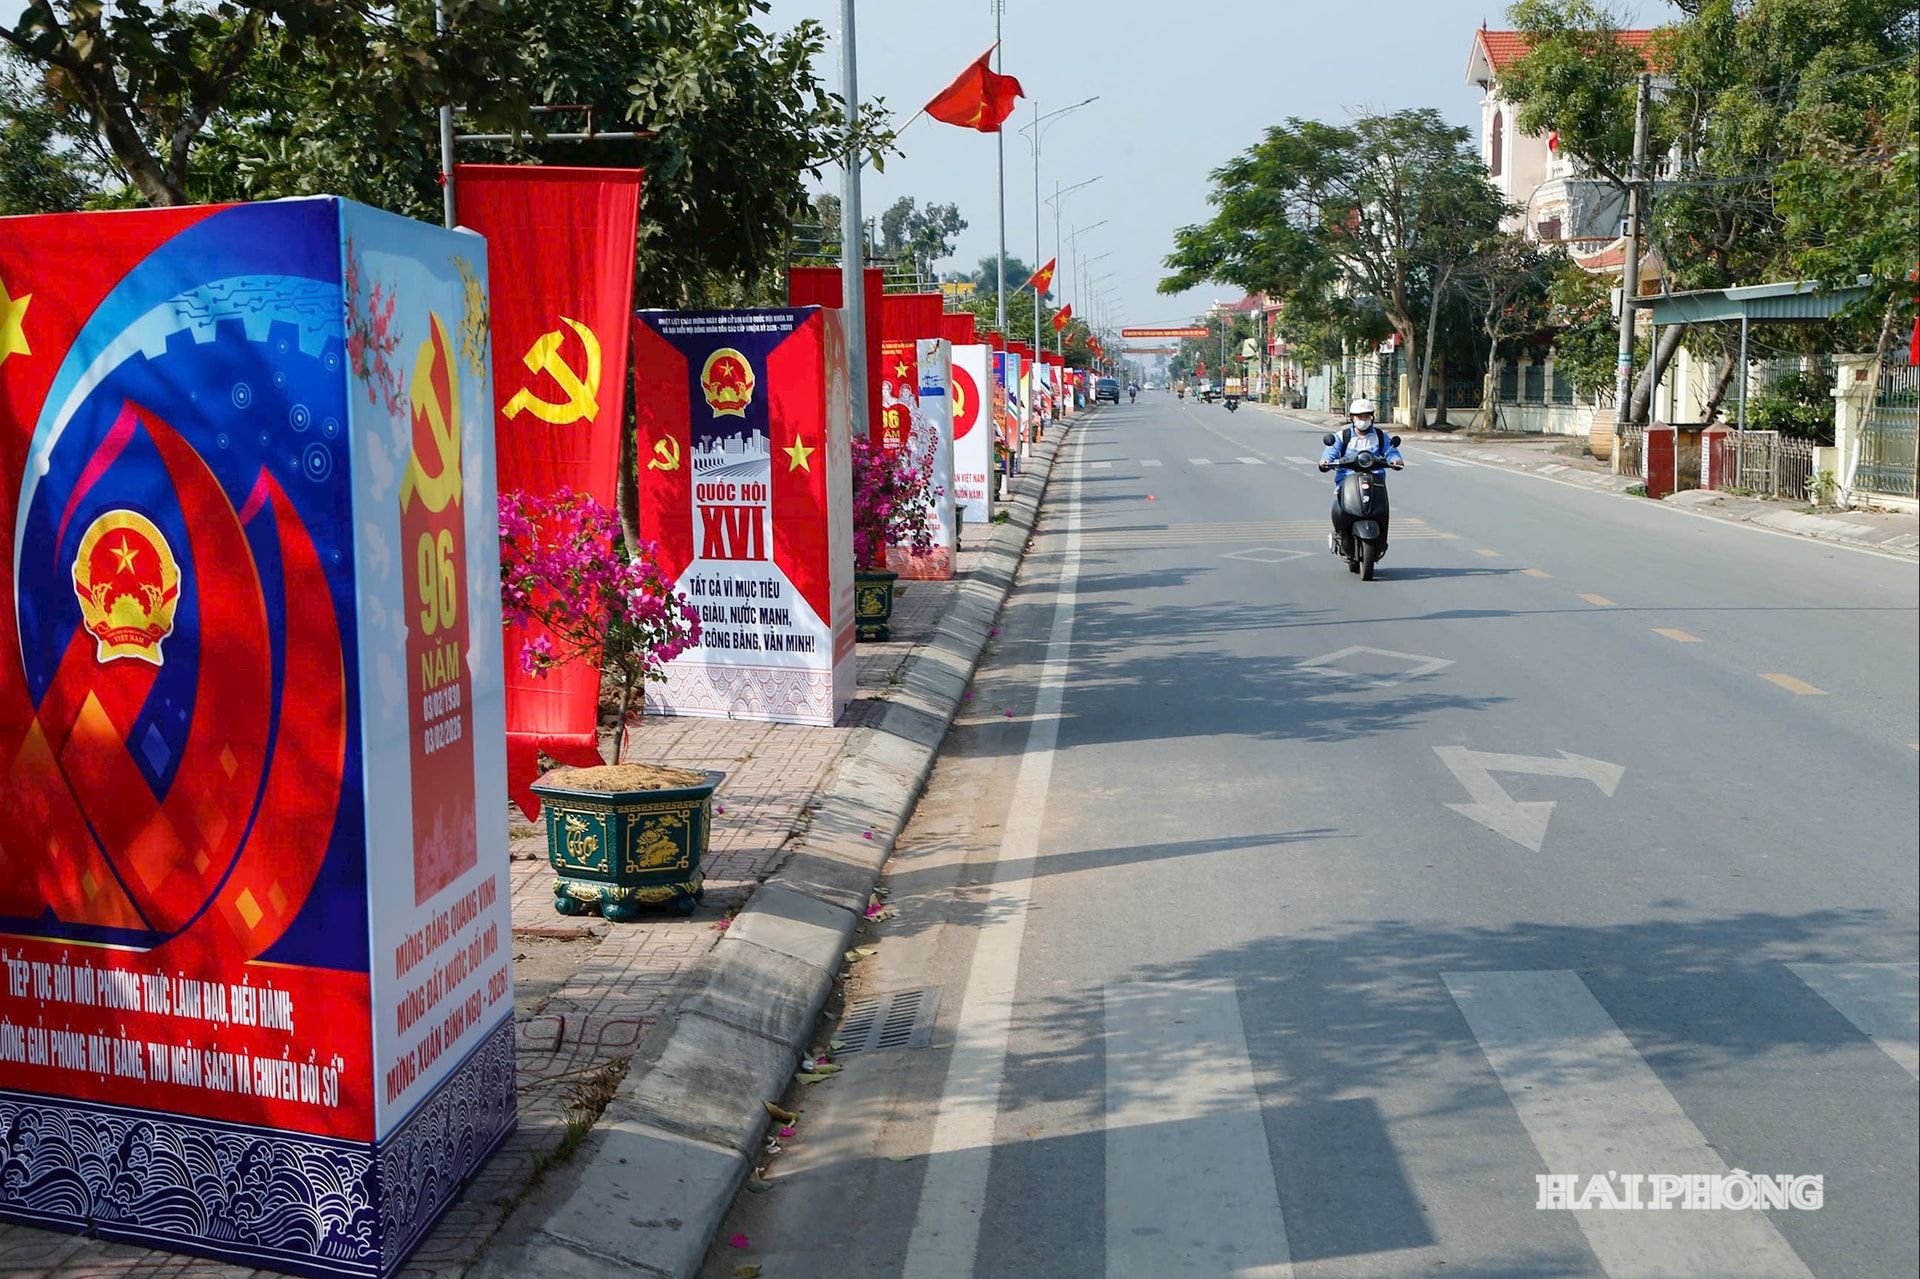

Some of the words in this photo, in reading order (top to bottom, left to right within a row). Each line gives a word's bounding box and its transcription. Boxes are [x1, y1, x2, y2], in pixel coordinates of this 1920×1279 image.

[696, 478, 736, 501] QUỐC
[742, 481, 767, 504] HỘI
[697, 505, 768, 561] XVI
[418, 528, 457, 636] 96
[690, 573, 706, 596] TẤT
[709, 572, 721, 596] CẢ
[724, 576, 733, 597] VÌ
[736, 581, 756, 601] MỤC
[759, 578, 779, 599] TIÊU
[702, 602, 727, 624] GIÀU,
[730, 601, 756, 624] NƯỚC
[760, 608, 792, 628] MẠNH,
[705, 628, 730, 648] CÔNG
[733, 625, 761, 652] BẰNG,
[764, 629, 782, 651] VĂN
[786, 636, 815, 653] MINH!
[421, 635, 460, 692] NĂM
[423, 684, 460, 722] 03/02/1930
[424, 715, 462, 756] 03/02/2026
[395, 930, 424, 980] MỪNG
[426, 910, 449, 955] ĐẢNG
[451, 896, 477, 941] QUANG
[478, 874, 496, 912] VINH
[32, 962, 52, 1008] TỤC
[54, 950, 72, 1003] ĐỔI
[74, 959, 95, 1005] MỚI
[97, 968, 140, 1012] PHƯƠNG
[142, 968, 171, 1015] THỨC
[172, 972, 201, 1019] LÃNH
[203, 981, 229, 1031] ĐẠO,
[231, 973, 257, 1027] ĐIỀU
[259, 980, 294, 1036] HÀNH;
[396, 989, 425, 1037] MỪNG
[426, 960, 444, 1012] ĐẤT
[445, 947, 467, 993] NƯỚC
[468, 926, 482, 972] ĐỔI
[483, 919, 498, 962] MỚI
[0, 1015, 25, 1063] ƯỜNG
[28, 1015, 48, 1066] GIẢI
[50, 1024, 86, 1071] PHÓNG
[88, 1028, 110, 1082] MẶT
[113, 1024, 146, 1083] BẰNG,
[148, 1043, 168, 1083] THU
[171, 1039, 201, 1087] NGÂN
[204, 1043, 234, 1092] SÁCH
[235, 1047, 251, 1095] VÀ
[253, 1045, 298, 1101] CHUYỂN
[301, 1048, 320, 1104] ĐỔI
[386, 1052, 416, 1105] MỪNG
[417, 1027, 442, 1073] XUÂN
[444, 1008, 464, 1050] BÍNH
[466, 988, 482, 1029] NGỌ
[488, 964, 508, 1007] 2026!
